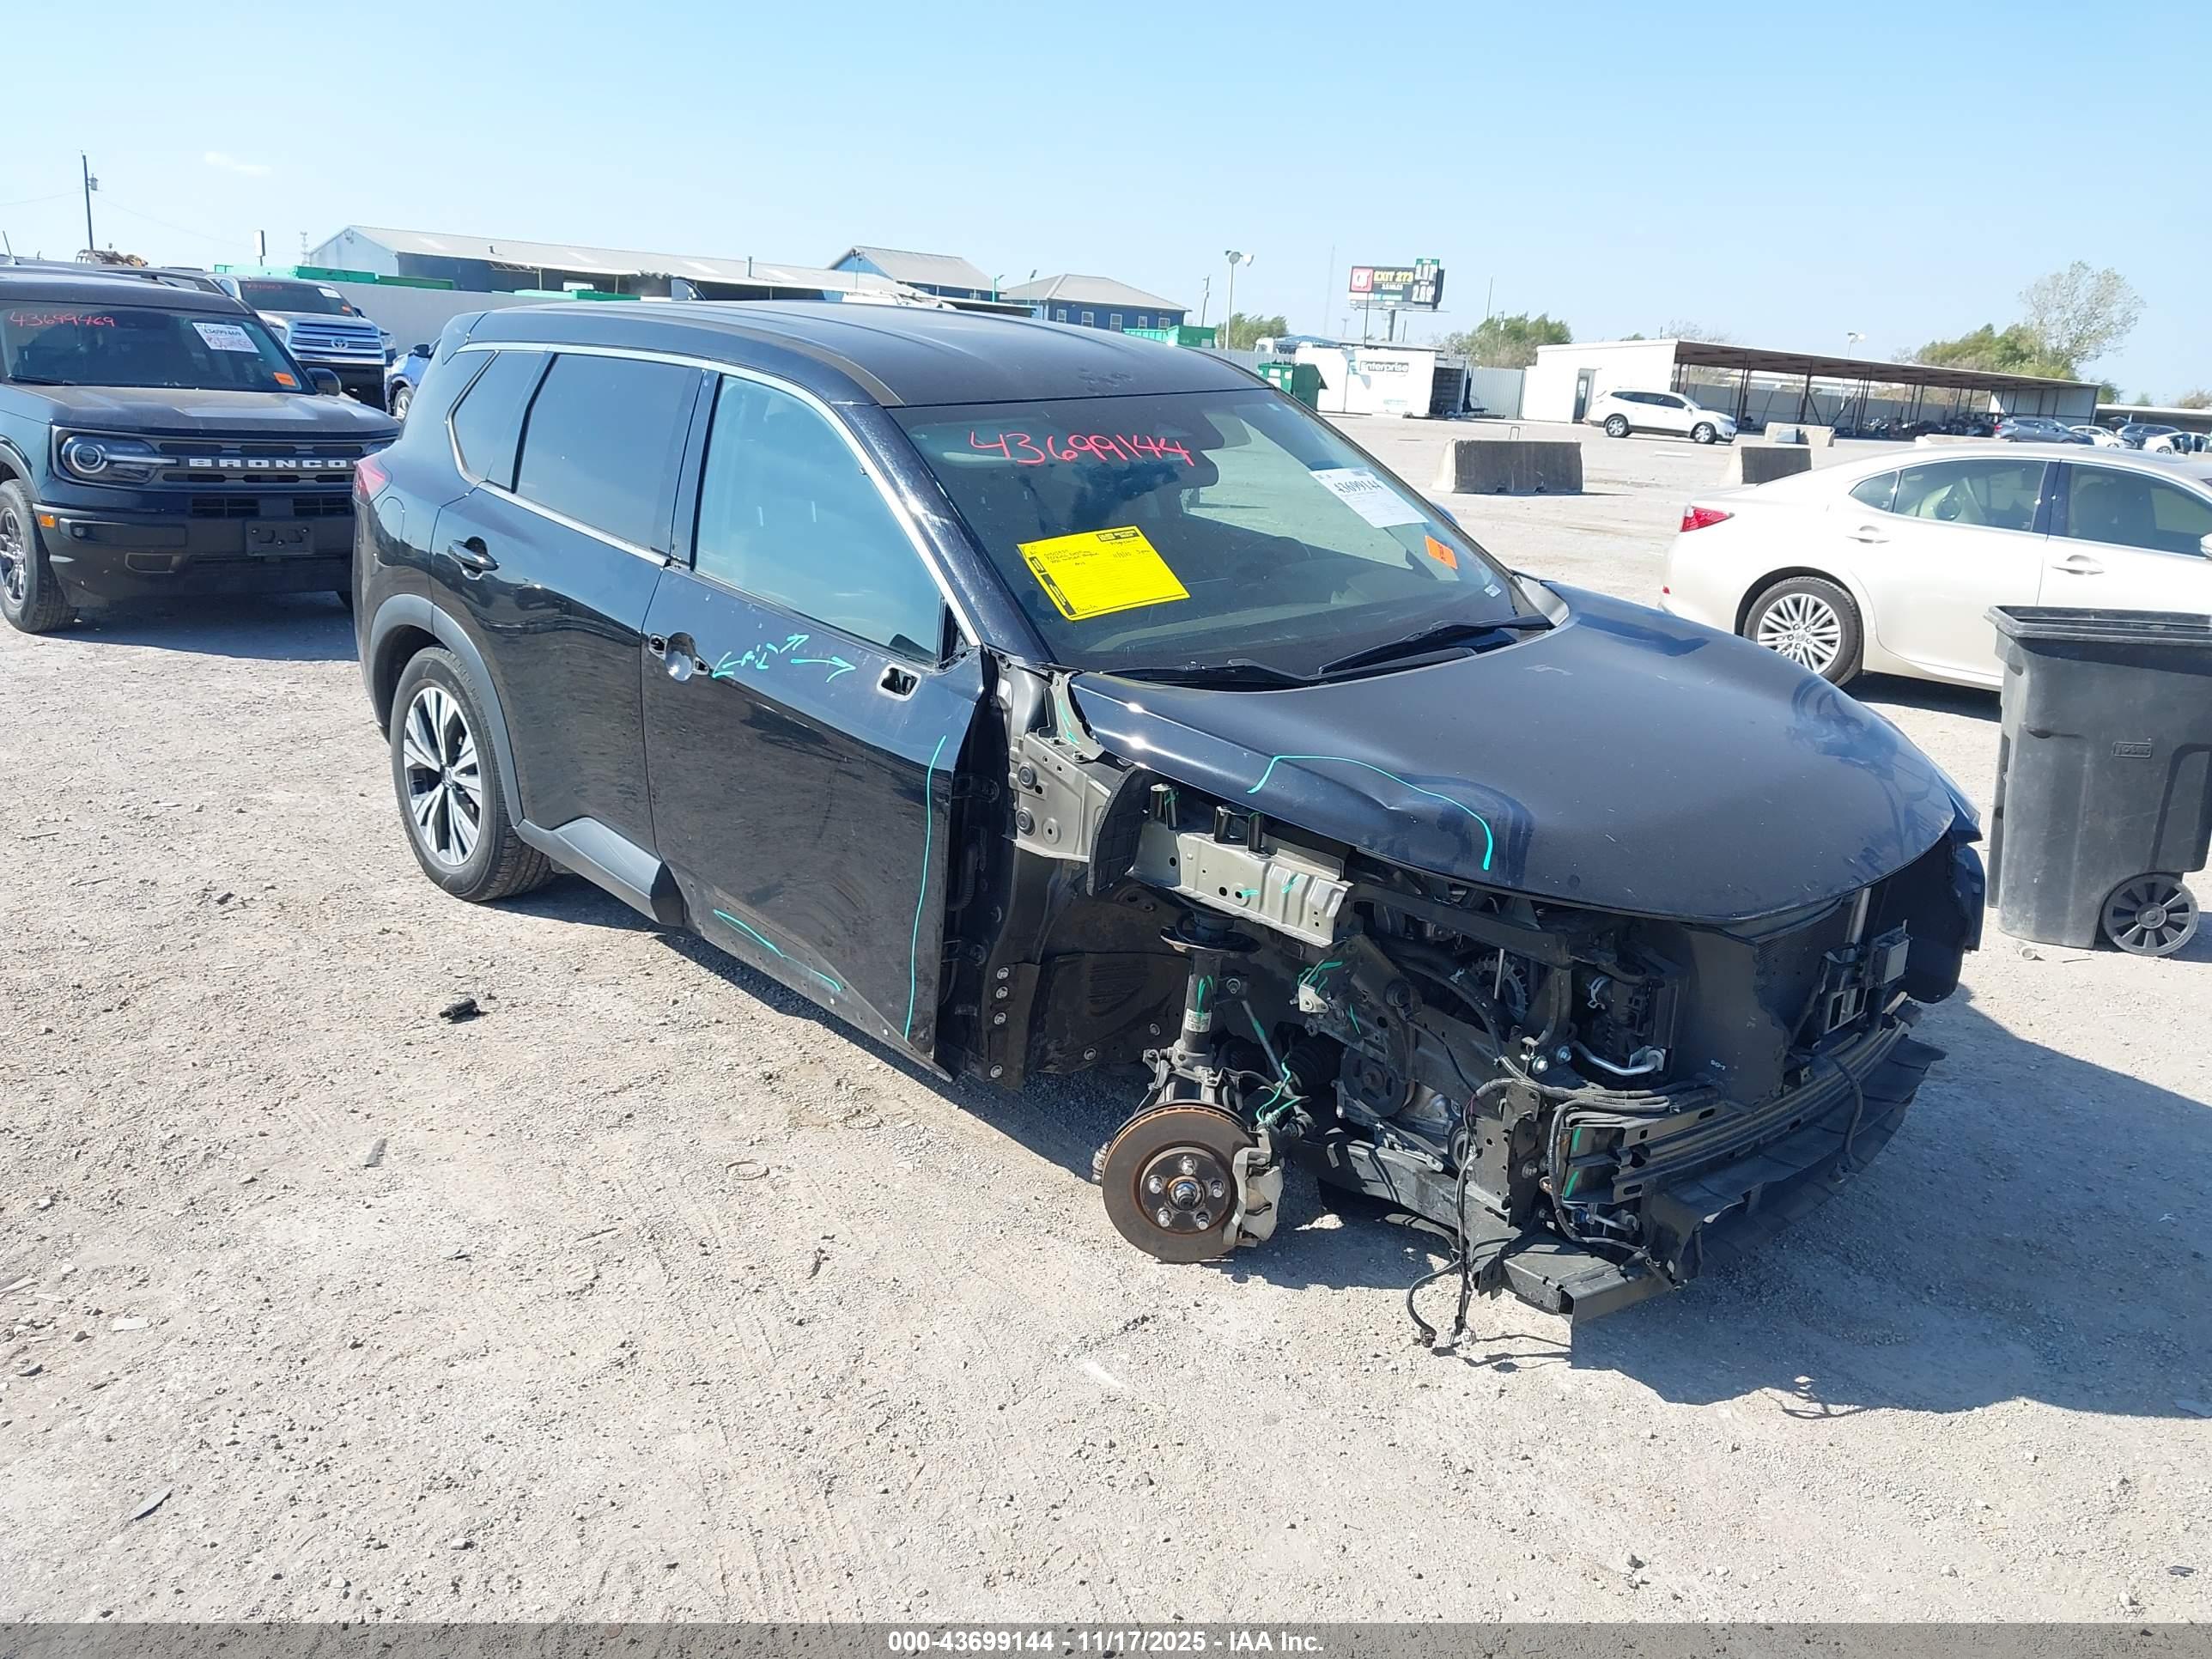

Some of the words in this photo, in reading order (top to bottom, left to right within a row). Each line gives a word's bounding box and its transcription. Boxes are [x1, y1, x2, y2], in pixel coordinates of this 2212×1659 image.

[10, 311, 115, 327] 43699469
[1360, 361, 1409, 373] Enterprise
[970, 431, 1195, 467] 43699144
[188, 458, 347, 468] BRONCO
[1334, 480, 1383, 494] 43699144
